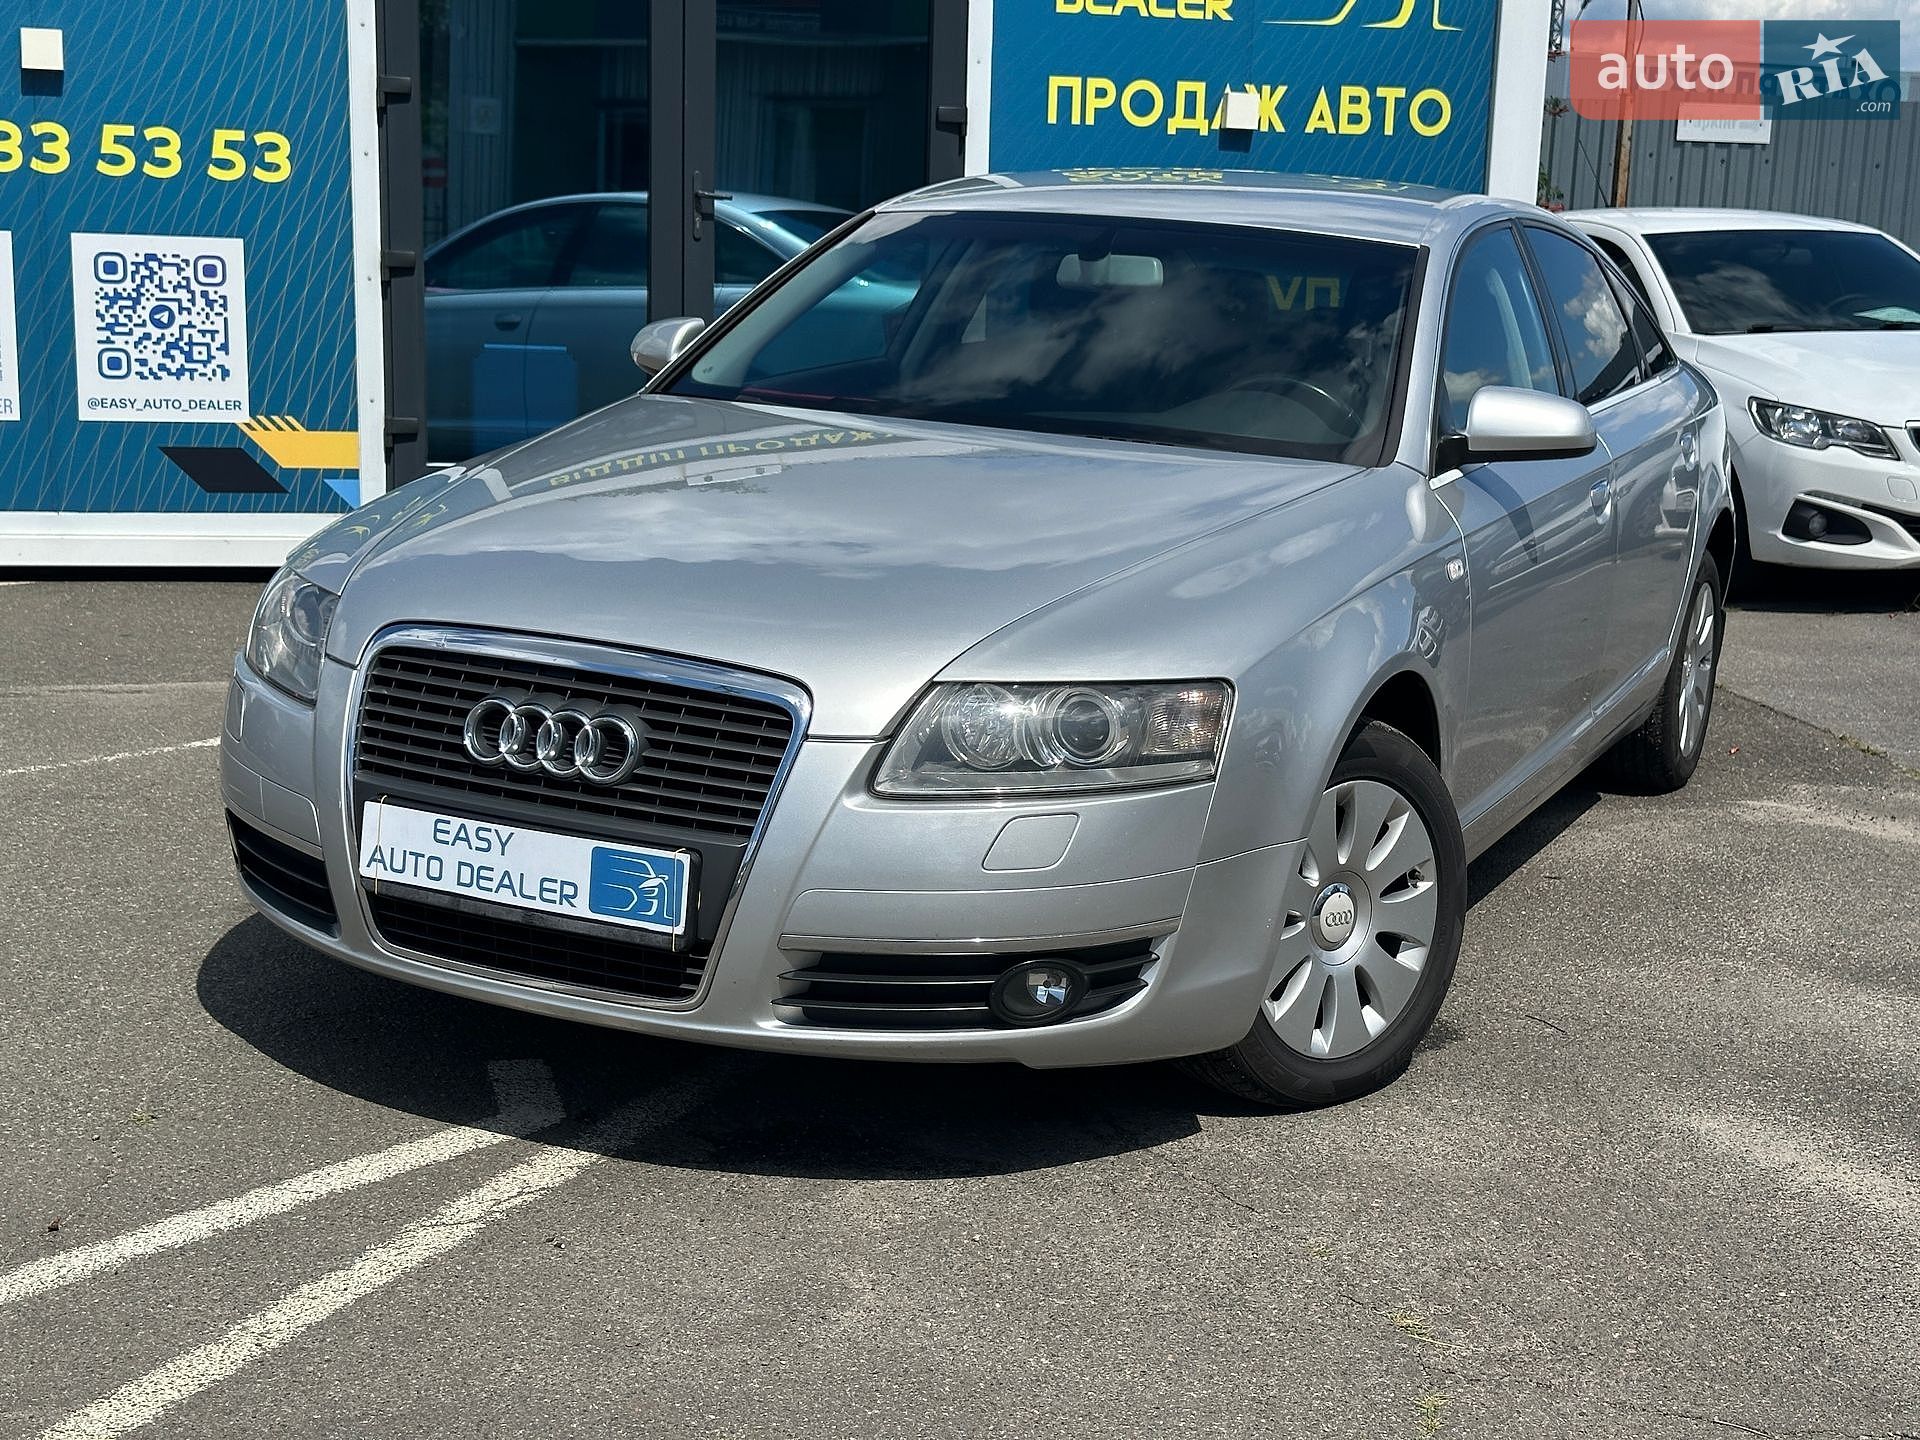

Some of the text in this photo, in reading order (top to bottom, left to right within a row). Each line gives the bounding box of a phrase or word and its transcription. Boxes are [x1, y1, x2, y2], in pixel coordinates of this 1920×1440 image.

[1304, 85, 1453, 137] АВТО
[96, 123, 183, 179] 53
[207, 128, 292, 184] 53
[87, 397, 243, 412] @EASY_AUTO_DEALER
[433, 818, 515, 857] EASY
[366, 844, 579, 908] AUTO DEALER
